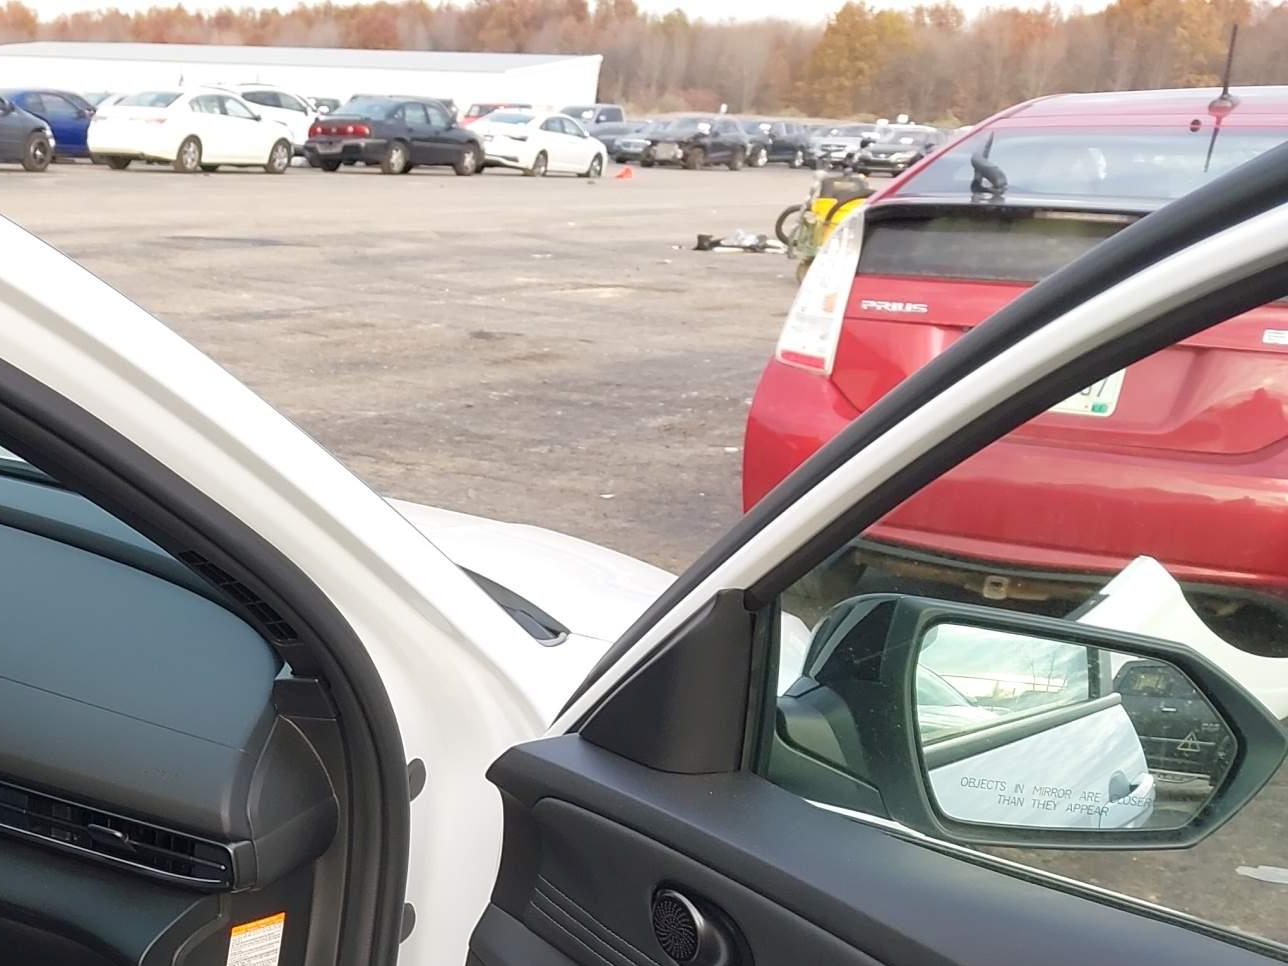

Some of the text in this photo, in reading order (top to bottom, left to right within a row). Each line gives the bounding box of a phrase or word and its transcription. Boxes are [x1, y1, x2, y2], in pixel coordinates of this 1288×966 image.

[861, 299, 929, 313] PRIUS
[960, 776, 1007, 792] OBJECTS
[1014, 783, 1025, 794] IN
[1032, 785, 1073, 799] MIRROR
[1079, 791, 1102, 804] ARE
[997, 794, 1111, 817] THAN THEY APPEAR
